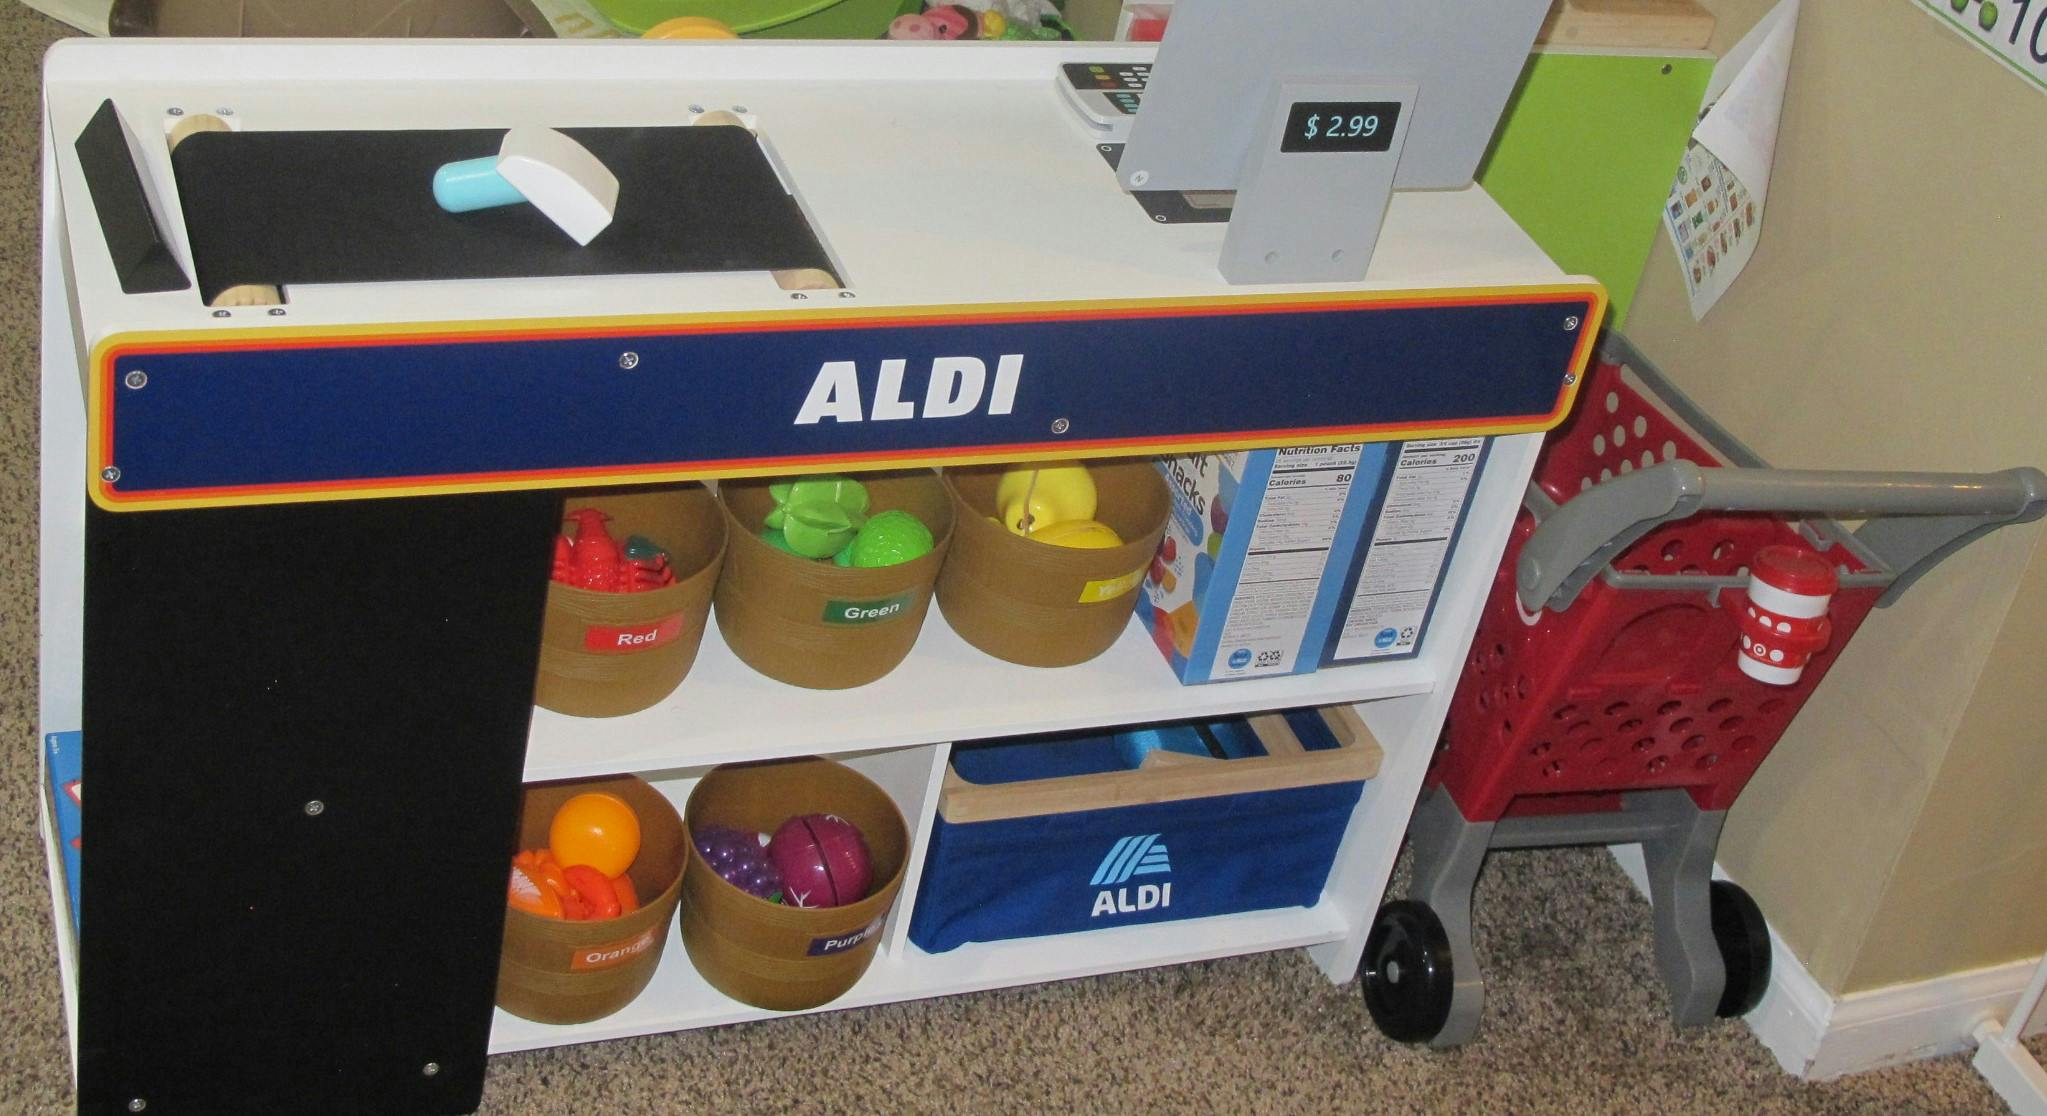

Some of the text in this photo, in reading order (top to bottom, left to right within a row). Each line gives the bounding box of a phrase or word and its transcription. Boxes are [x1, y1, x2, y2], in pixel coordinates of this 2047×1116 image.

[1304, 113, 1379, 140] $ 2.99
[793, 353, 1025, 425] ALDI
[1279, 444, 1360, 456] Nutrition Facts
[1400, 458, 1437, 467] Calories
[1453, 453, 1476, 463] 200
[1160, 454, 1205, 515] nacks
[1269, 473, 1352, 487] Calories 80
[844, 603, 900, 619] Green
[617, 629, 658, 646] Red
[1090, 882, 1172, 917] ALDI
